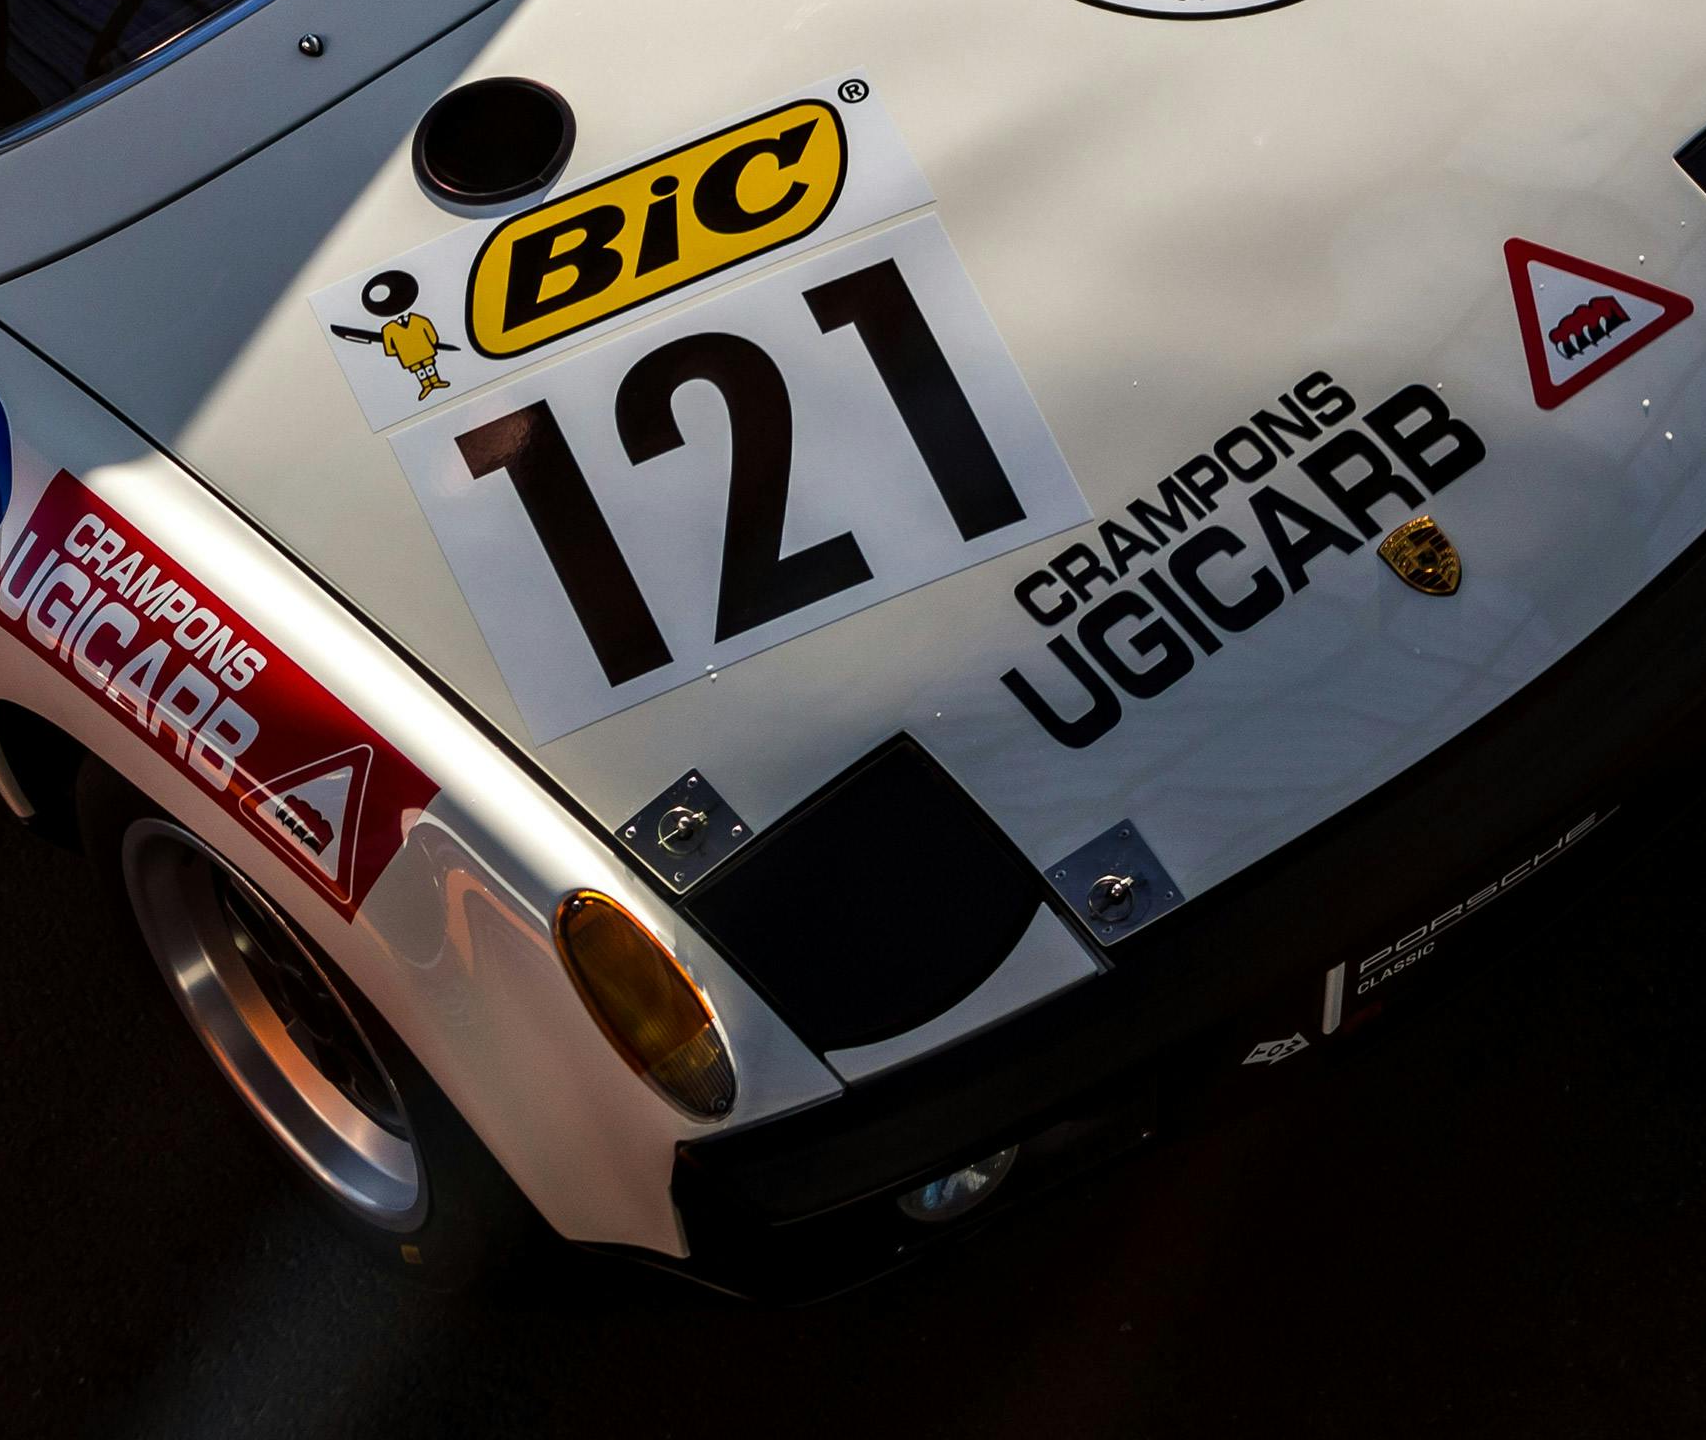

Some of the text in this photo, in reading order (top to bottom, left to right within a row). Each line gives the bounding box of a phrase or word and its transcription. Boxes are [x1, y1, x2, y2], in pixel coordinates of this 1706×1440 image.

[454, 257, 1027, 688] 121
[999, 384, 1487, 749] UGICARB
[1013, 370, 1357, 627] CRAMPONS
[64, 513, 266, 691] CRAMPONS
[1357, 942, 1435, 995] CLASSIC
[1359, 812, 1597, 974] PORSCHE
